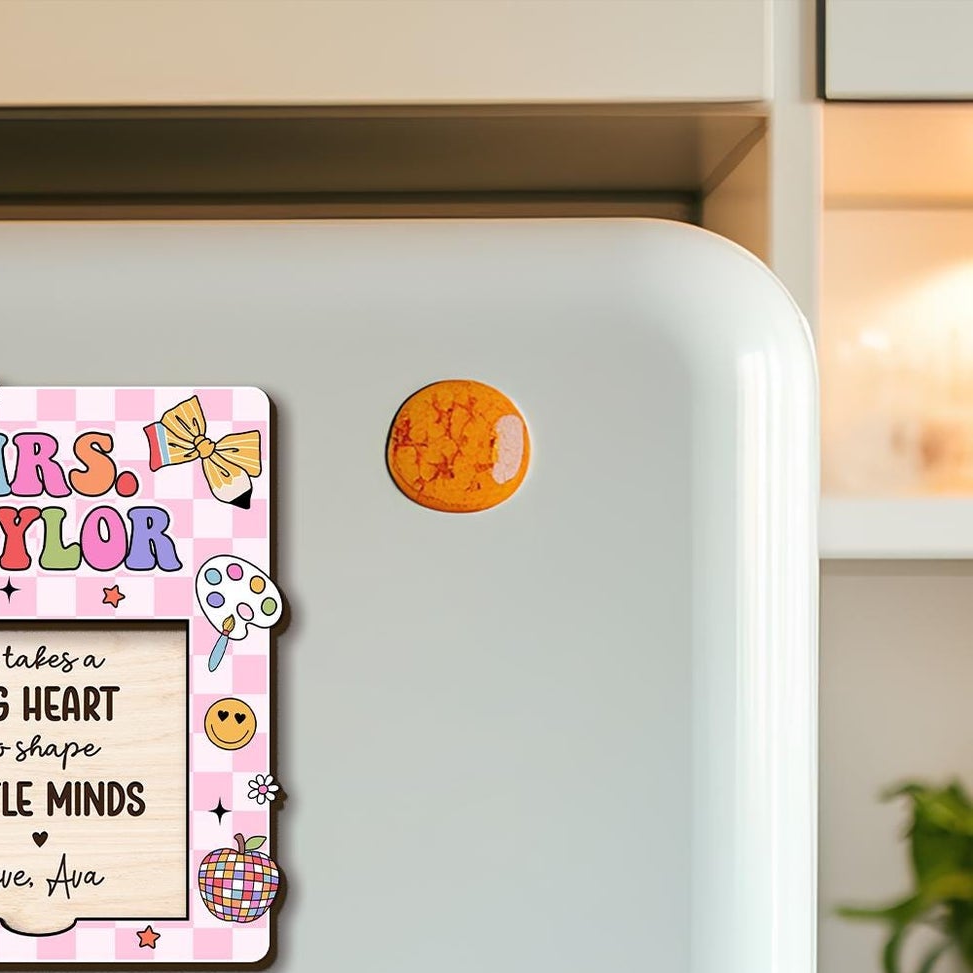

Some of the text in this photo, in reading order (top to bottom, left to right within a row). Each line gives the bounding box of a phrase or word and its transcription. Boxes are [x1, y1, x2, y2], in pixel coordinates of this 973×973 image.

[3, 645, 79, 673] takes
[83, 653, 106, 669] a
[22, 685, 121, 722] HEART
[15, 734, 101, 770] shape
[46, 780, 146, 817] MINDS
[46, 853, 105, 899] Ava
